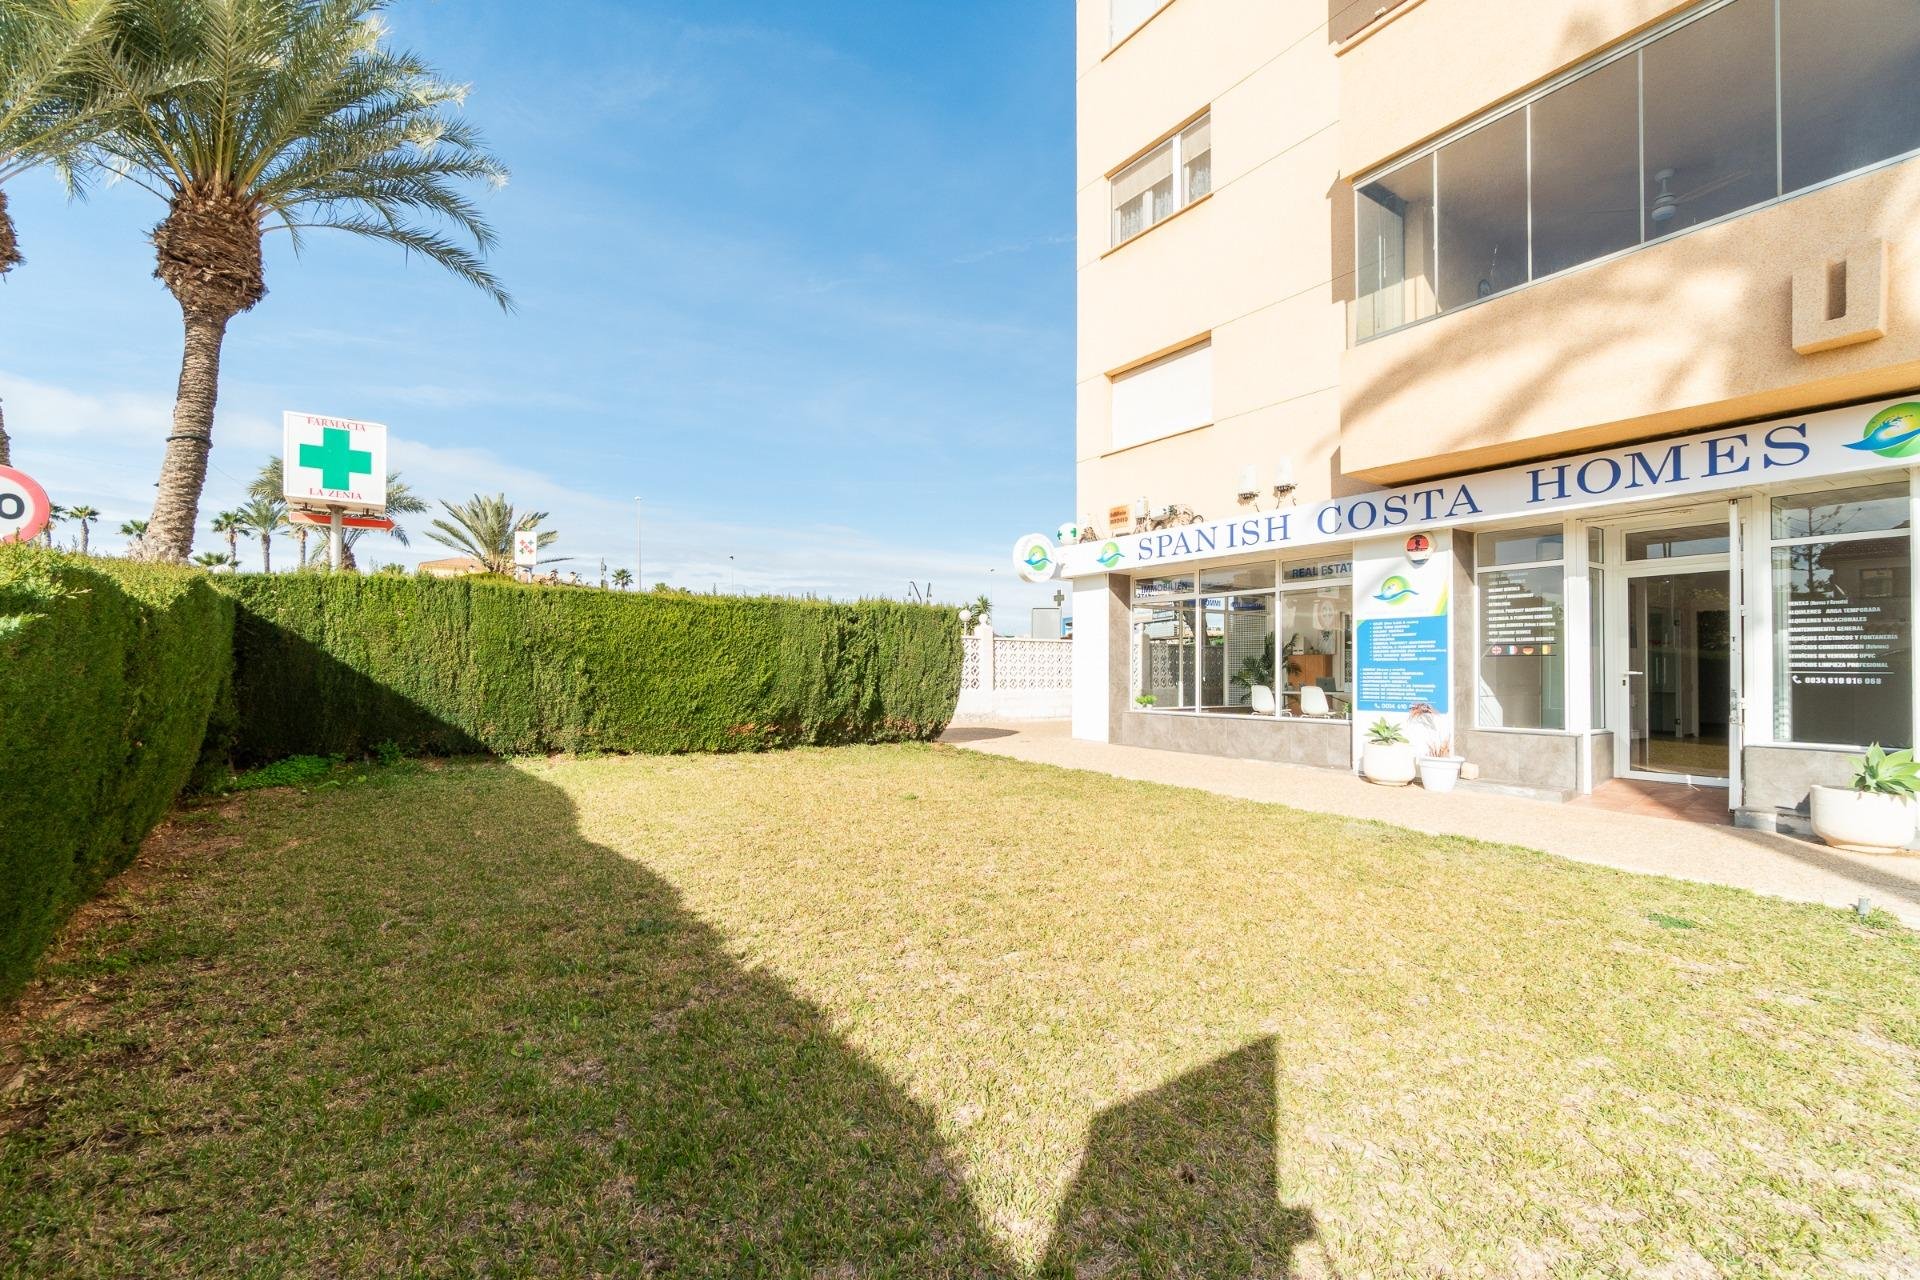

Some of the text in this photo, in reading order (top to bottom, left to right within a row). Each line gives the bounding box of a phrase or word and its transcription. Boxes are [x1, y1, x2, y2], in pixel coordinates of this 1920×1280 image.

[306, 416, 366, 432] FARMACIA
[309, 488, 362, 500] LA ZENIA
[1138, 422, 1811, 561] SPANISH COSTA HOMES
[1292, 566, 1318, 578] REAL
[1141, 580, 1188, 593] IMMOBILIEN
